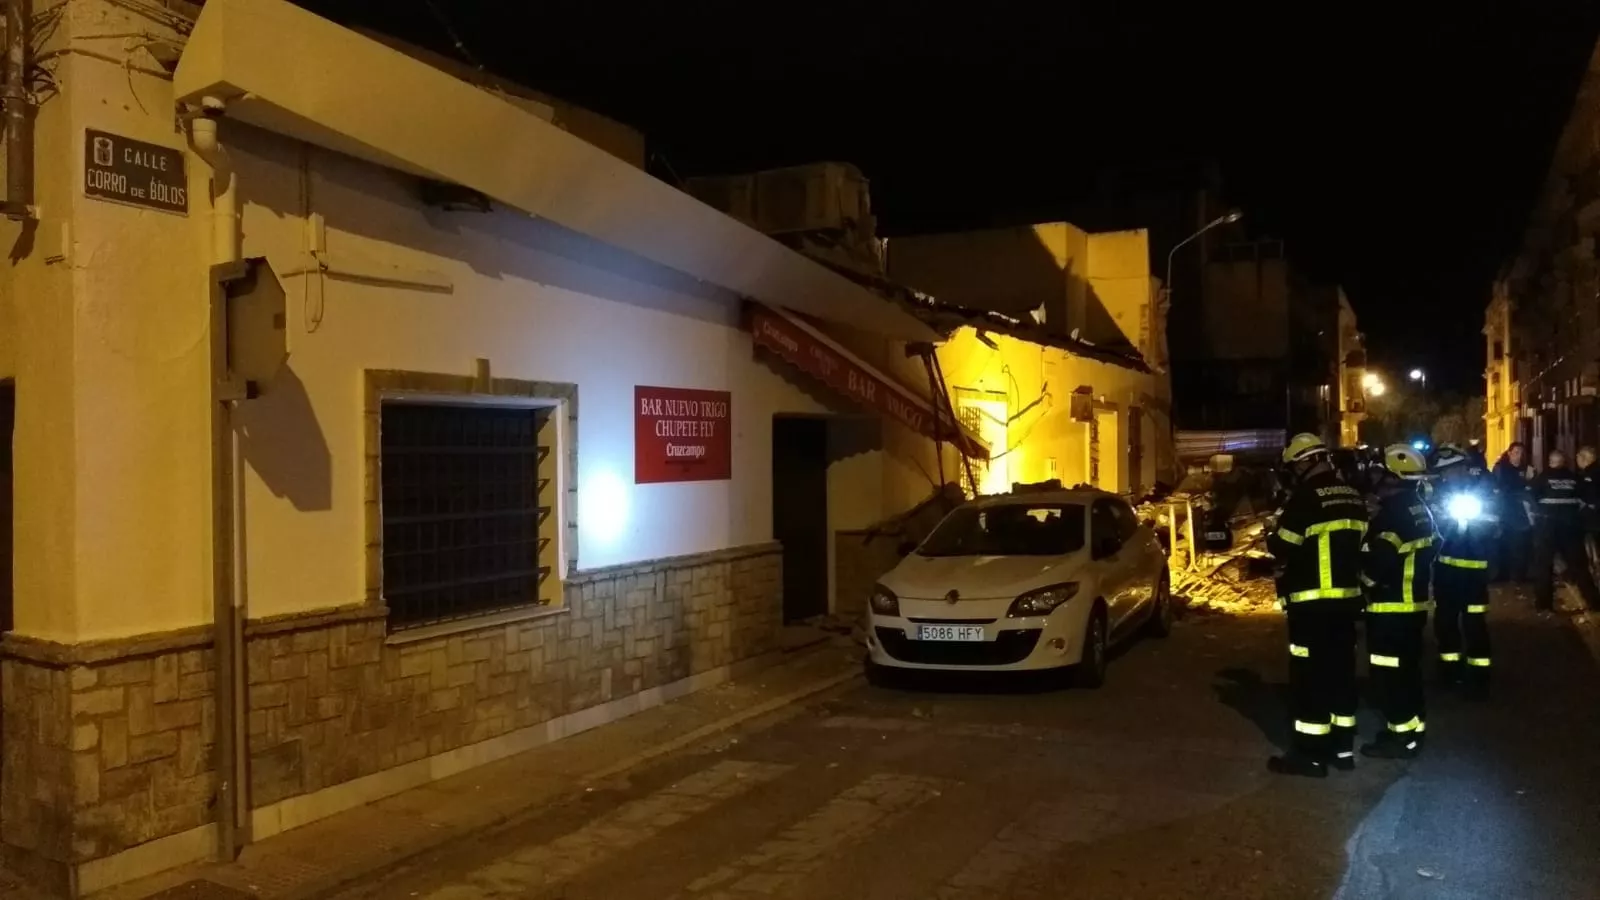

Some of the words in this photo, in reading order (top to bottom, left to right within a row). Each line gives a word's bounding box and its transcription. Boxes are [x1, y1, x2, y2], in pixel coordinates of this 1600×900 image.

[124, 148, 167, 171] CALLE
[87, 168, 127, 194] CORRO
[130, 186, 146, 199] DE
[848, 369, 876, 403] BAR
[641, 398, 663, 416] BAR
[665, 399, 699, 417] NUEVO
[700, 401, 727, 418] TRIGO
[655, 420, 699, 437] CHUPETE
[700, 421, 716, 438] FLY
[666, 442, 705, 459] Cruzcampo
[923, 627, 954, 640] 5086
[958, 627, 982, 640] HFY
